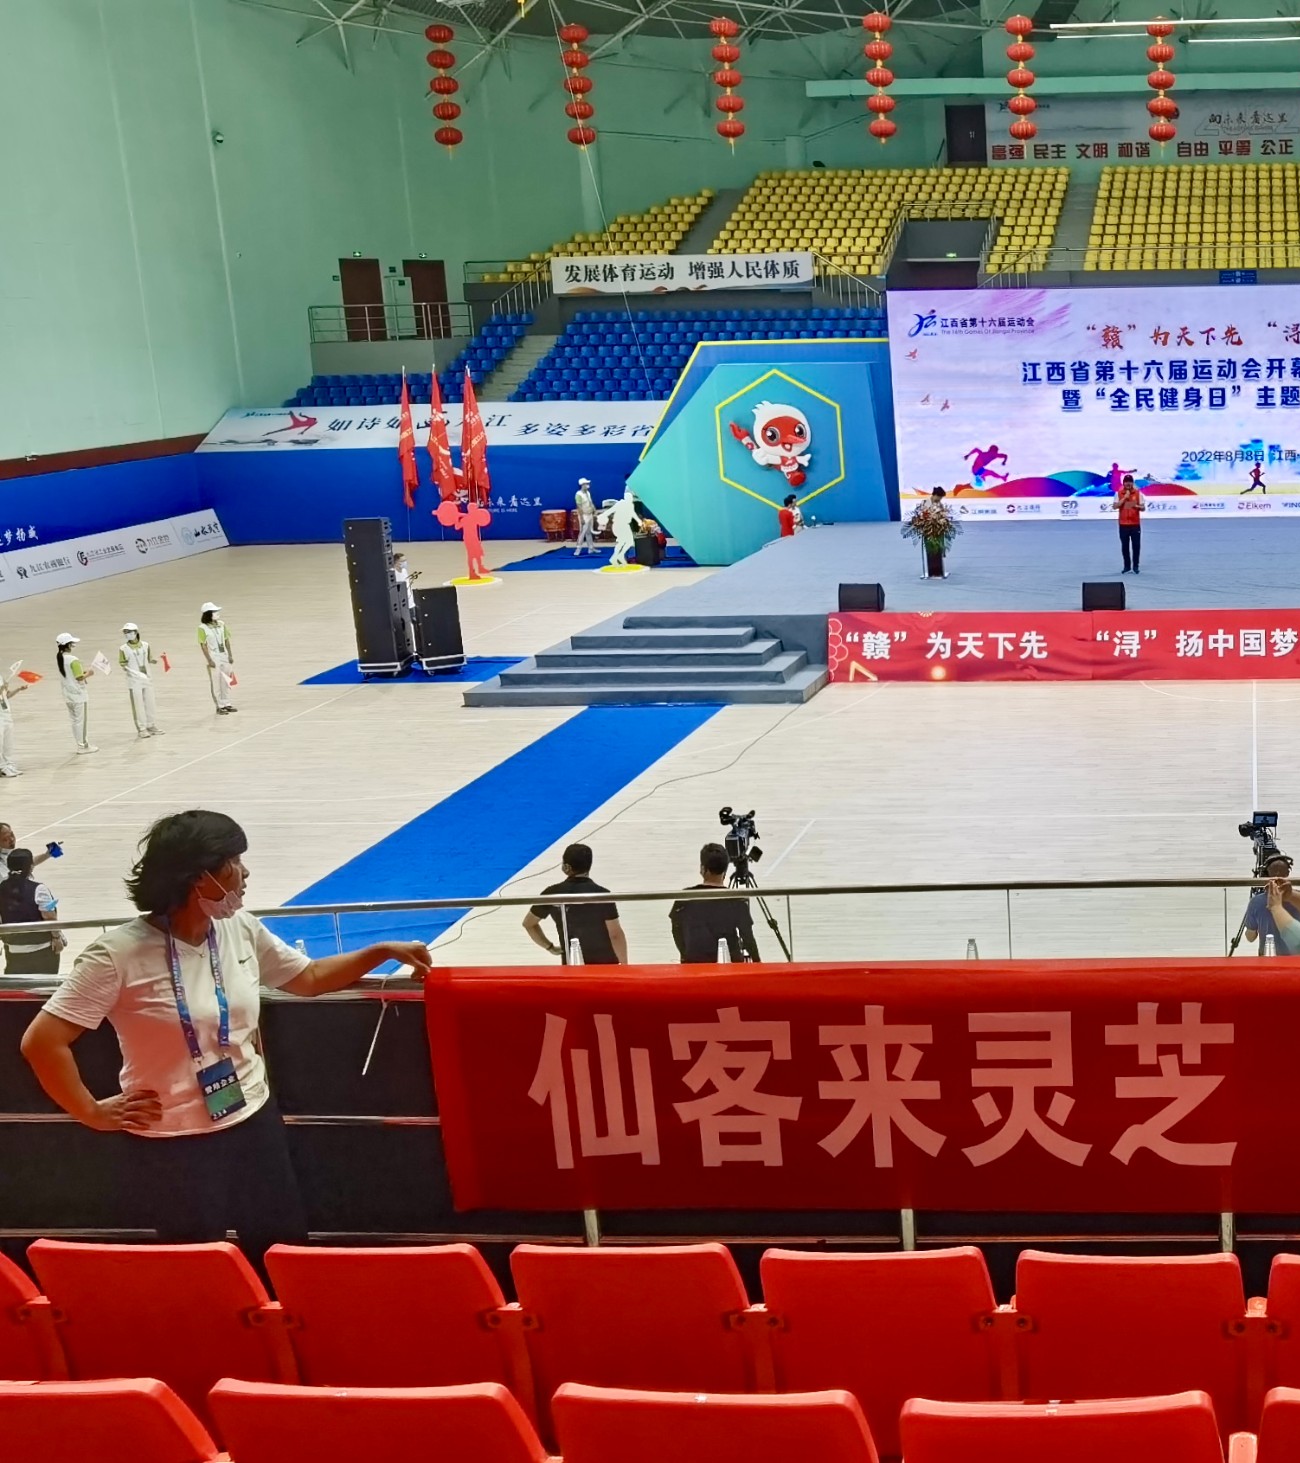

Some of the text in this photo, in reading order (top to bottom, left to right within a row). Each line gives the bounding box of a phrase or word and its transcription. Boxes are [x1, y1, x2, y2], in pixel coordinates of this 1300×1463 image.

[1033, 144, 1066, 159] 民主
[1076, 142, 1108, 158] 文明
[1118, 142, 1150, 158] 和谐
[1177, 141, 1209, 157] 自由
[1260, 139, 1294, 155] 公正
[564, 259, 800, 283] 发展体育运动 增强人民体质
[941, 317, 1035, 328] 江西省第十六届运动会
[1182, 450, 1265, 462] 2022年8月8日
[526, 1001, 1238, 1170] 仙客来灵芝
